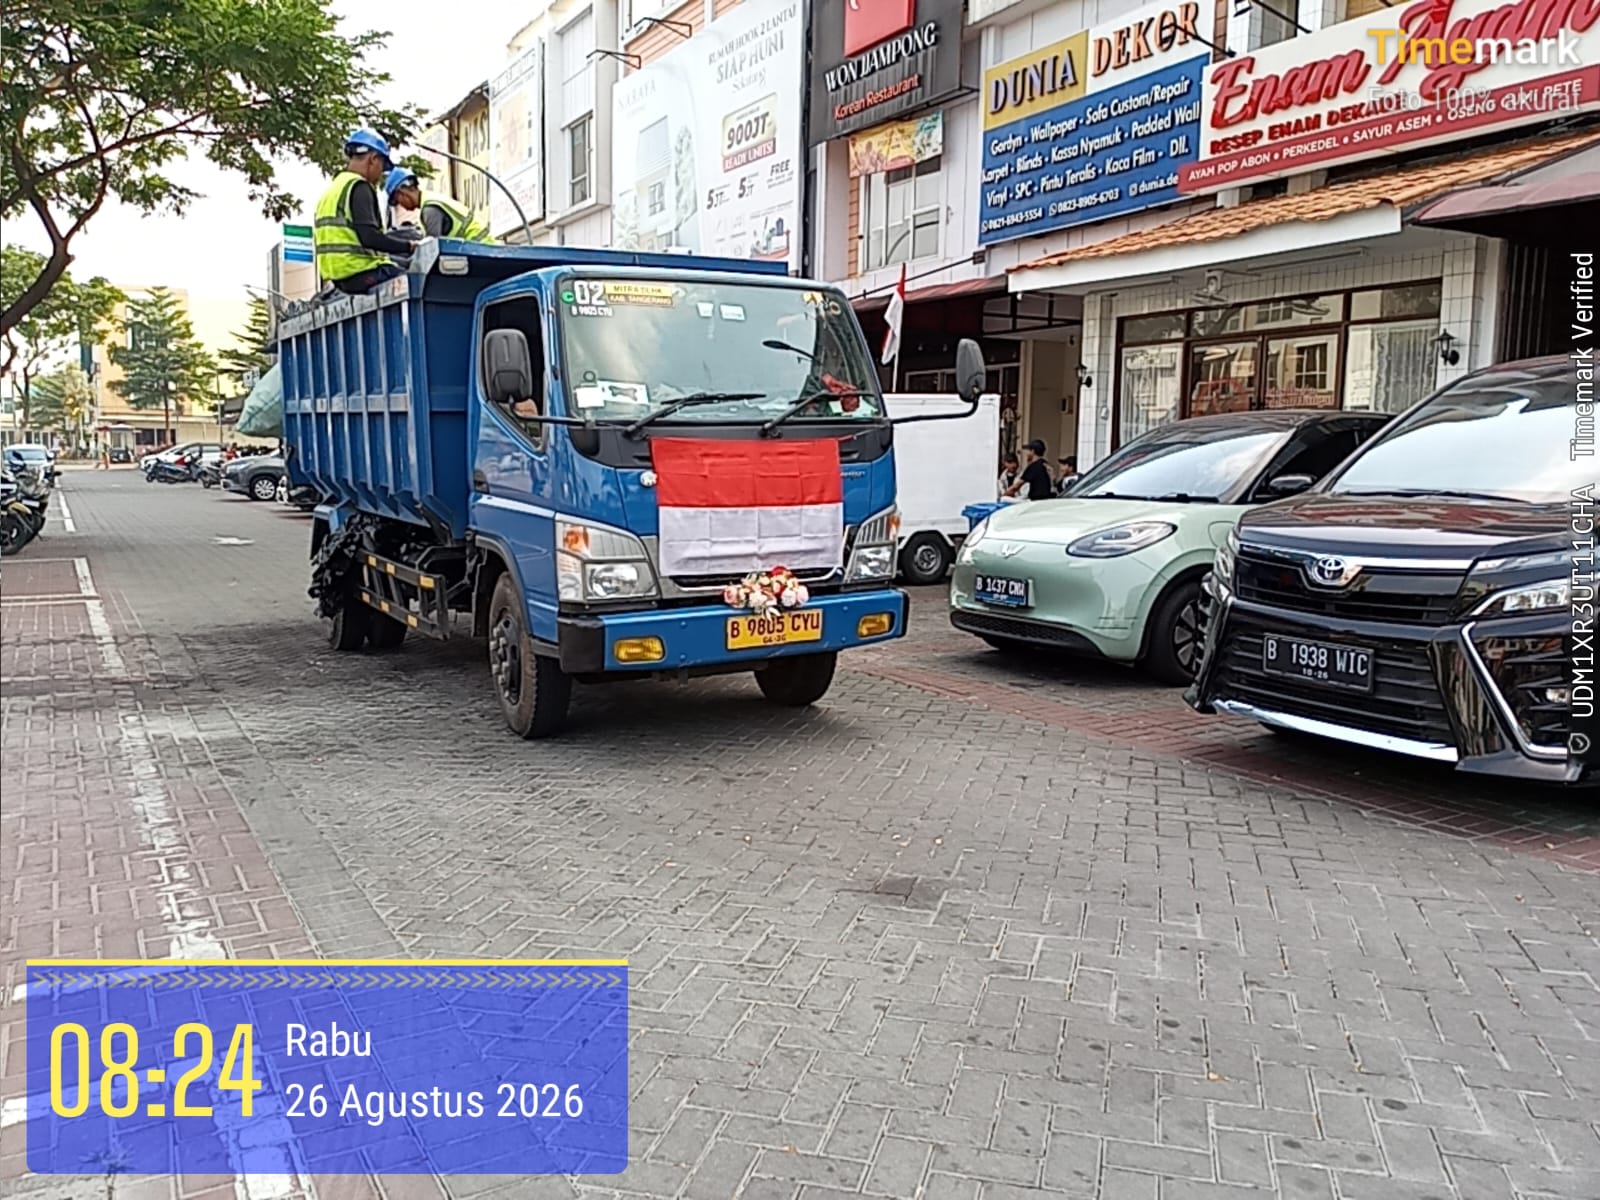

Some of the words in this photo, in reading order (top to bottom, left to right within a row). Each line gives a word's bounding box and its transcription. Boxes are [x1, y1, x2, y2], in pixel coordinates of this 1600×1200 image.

[717, 51, 746, 84] SIAP
[749, 30, 784, 67] HUNI
[825, 60, 858, 92] WON
[989, 50, 1078, 115] DUNIA
[1092, 1, 1200, 77] DEKOR
[834, 97, 866, 119] Korean
[866, 73, 919, 106] Restaurant
[1030, 117, 1077, 144] Wallpaper
[1086, 102, 1108, 125] Sofa
[1110, 76, 1190, 116] Custom/Repair
[1210, 55, 1372, 130] Enam
[1016, 152, 1043, 173] Blinds
[1051, 144, 1078, 164] Kassa
[1080, 126, 1121, 157] Nyamuk
[1131, 109, 1172, 139] Padded
[1174, 101, 1200, 126] Wall
[1188, 165, 1216, 182] AYAM
[1218, 161, 1238, 176] POP
[1240, 153, 1271, 170] ABON
[1282, 137, 1340, 160] PERKEDEL
[1352, 121, 1393, 143] SAYUR
[1396, 113, 1432, 133] ASEM
[1447, 98, 1496, 121] OSENG
[1543, 78, 1583, 98] PETE
[1210, 129, 1263, 155] RESEP
[1268, 114, 1321, 141] ENAM
[724, 152, 748, 171] READY
[770, 159, 791, 177] FREE
[987, 186, 1007, 208] Vinyl
[1015, 180, 1032, 200] SPC
[1041, 175, 1063, 193] Pintu
[1065, 162, 1096, 186] Teralis
[1105, 157, 1130, 175] Kaca
[1132, 147, 1155, 168] Film
[574, 280, 606, 305] 02
[976, 577, 982, 590] B
[731, 621, 740, 639] B
[747, 615, 785, 637] 9805
[791, 613, 820, 631] CYU
[1267, 640, 1277, 660] B
[1291, 643, 1328, 668] 1938
[1335, 650, 1368, 676] WIC
